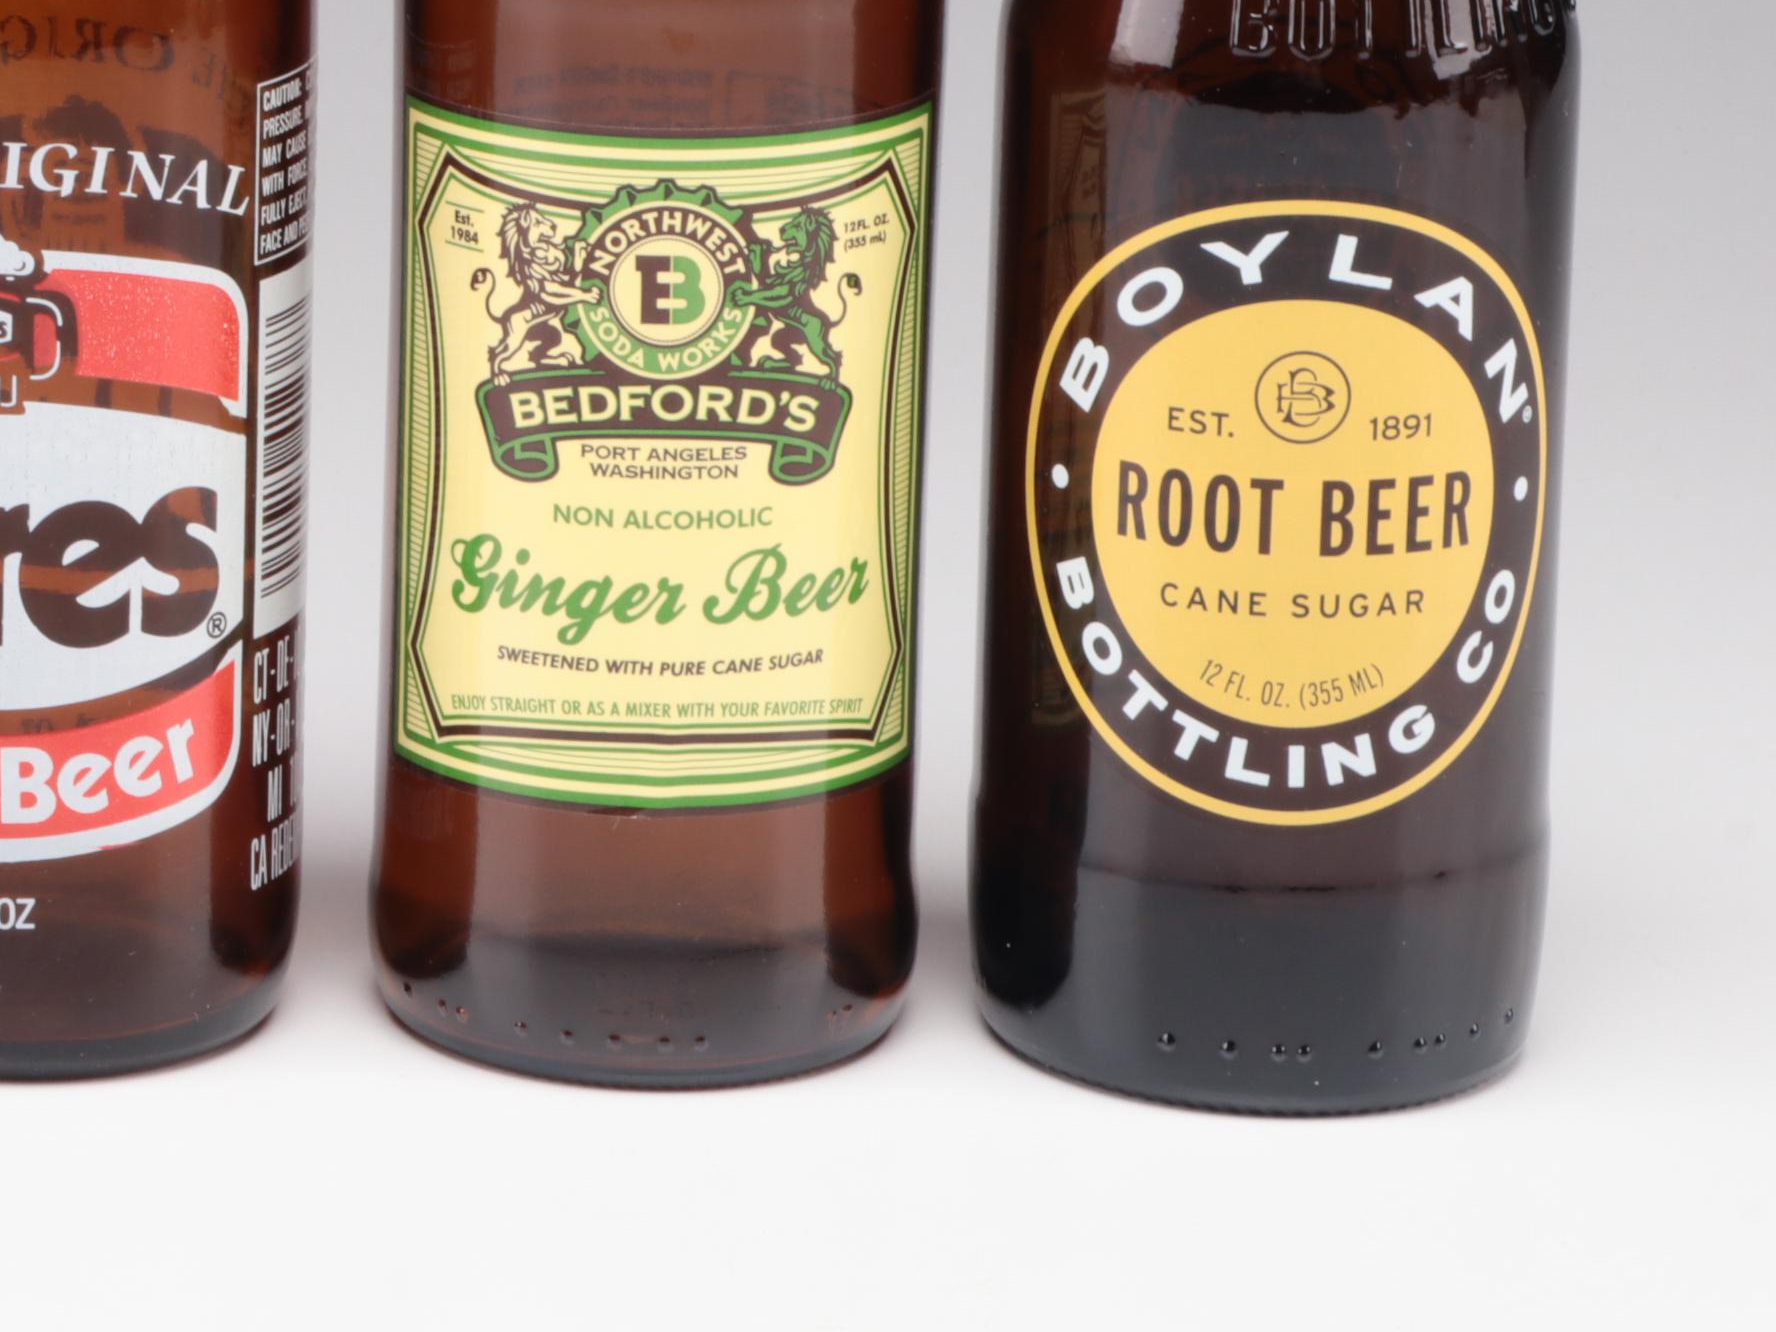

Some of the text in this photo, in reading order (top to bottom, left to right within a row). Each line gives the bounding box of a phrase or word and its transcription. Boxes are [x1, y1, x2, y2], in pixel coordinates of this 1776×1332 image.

[262, 143, 283, 168] MAY
[261, 170, 284, 197] WITH
[261, 198, 286, 226] FULLY
[454, 209, 475, 228] Est.
[260, 228, 282, 255] FACE
[283, 221, 298, 245] AND
[450, 226, 479, 246] 1984
[593, 211, 746, 276] NORTHWEST
[844, 232, 867, 252] (355
[591, 306, 743, 371] SODA WORKS
[1058, 231, 1527, 424] BOYLAN
[510, 384, 820, 432] BEDFORD'S
[1167, 407, 1234, 438] EST.
[1369, 412, 1433, 441] 1891
[581, 444, 747, 461] PORT ANGELES
[590, 463, 739, 479] WASHINGTON
[553, 503, 773, 530] NON ALCOHOLIC
[1117, 460, 1472, 557] ROOT BEER
[450, 533, 870, 646] Ginger Beer
[1159, 582, 1425, 619] CANE SUGAR
[498, 645, 823, 676] SWEETENED WITH PURE CANE SUGAR
[1056, 557, 1436, 790] BOTTLING
[1199, 659, 1384, 711] 12 FL. OZ. (355 ML)
[451, 694, 864, 718] ENJOY STRAIGHT OR AS A MIXER WITH YOUR FAVORITE SPIRIT
[0, 718, 196, 826] Beer
[250, 834, 268, 892] CA
